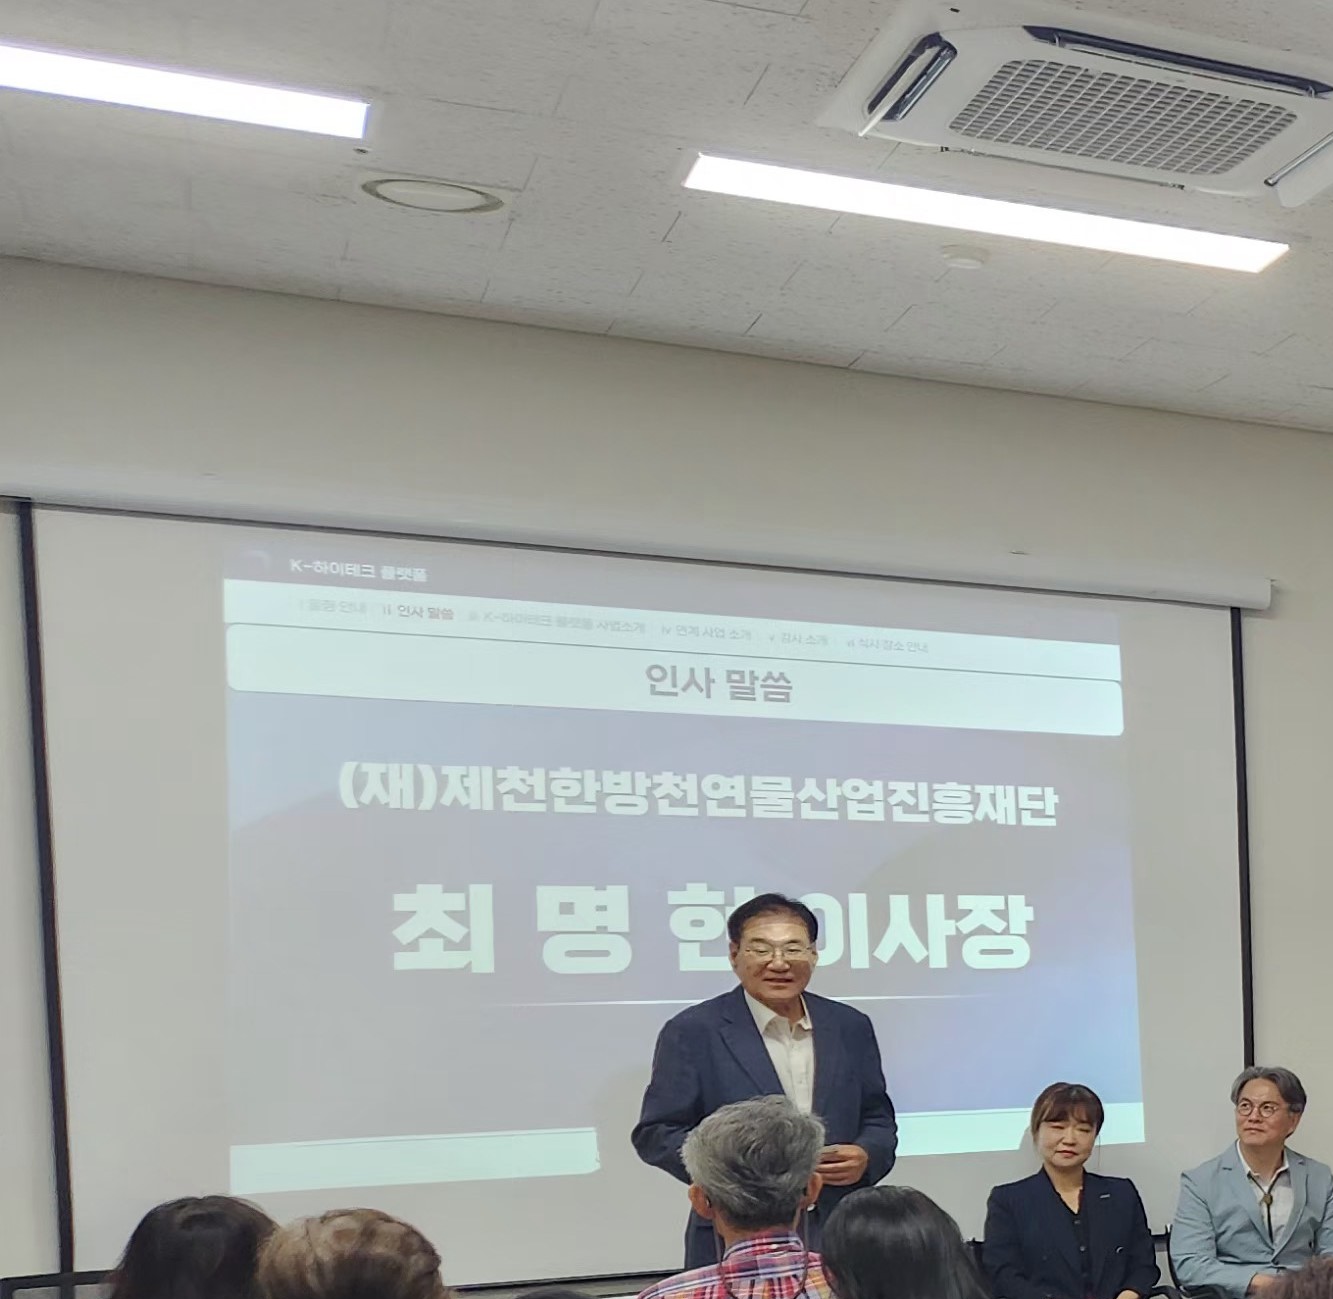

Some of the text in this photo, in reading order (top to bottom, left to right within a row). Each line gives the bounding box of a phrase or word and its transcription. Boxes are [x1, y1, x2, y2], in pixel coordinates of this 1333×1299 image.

[290, 558, 428, 582] K-하이테크 플랫폼
[397, 604, 425, 619] 인사
[427, 606, 454, 620] 말씀
[645, 664, 793, 703] 인사 말씀
[339, 761, 1060, 827] (재)제천한방천연물산업진흥재단
[392, 883, 495, 974] 최
[536, 884, 633, 974] 명
